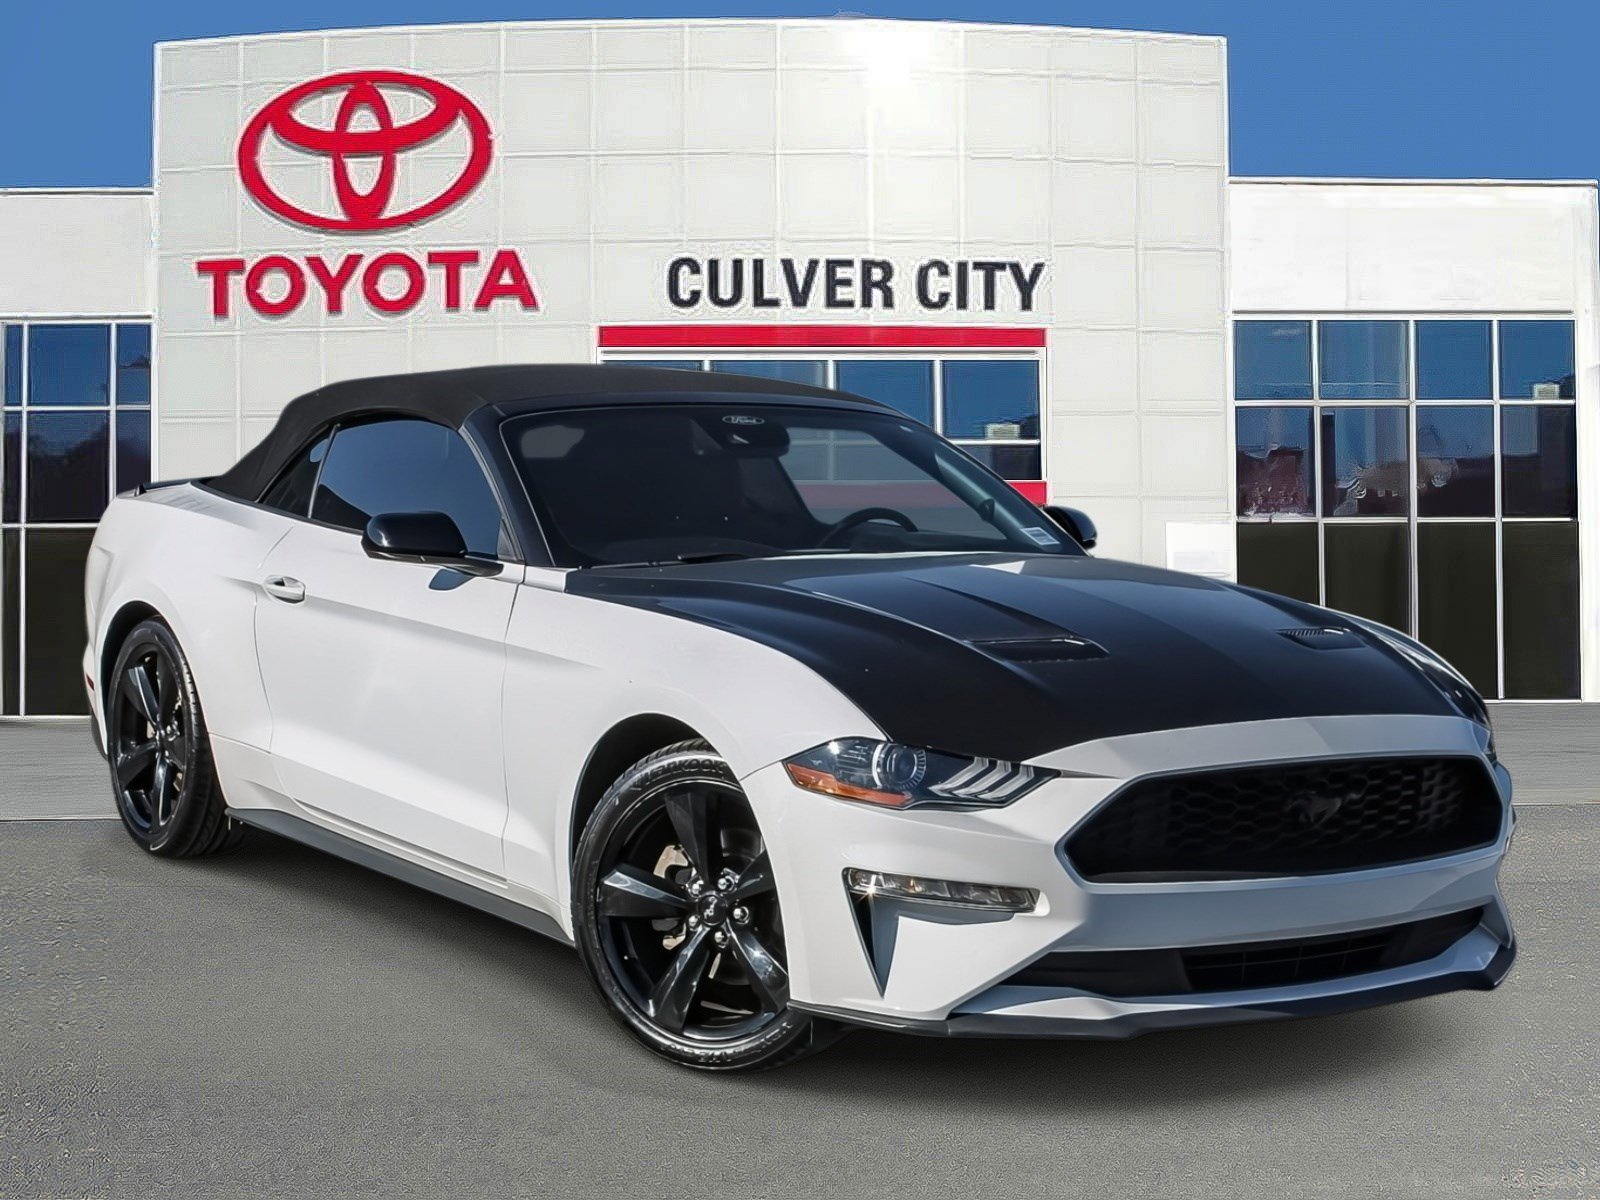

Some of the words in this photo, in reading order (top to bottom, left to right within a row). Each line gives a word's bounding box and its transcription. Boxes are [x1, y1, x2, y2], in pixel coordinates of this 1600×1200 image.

[196, 249, 540, 319] TOYOTA
[667, 257, 895, 309] CULVER
[916, 259, 1046, 311] CITY
